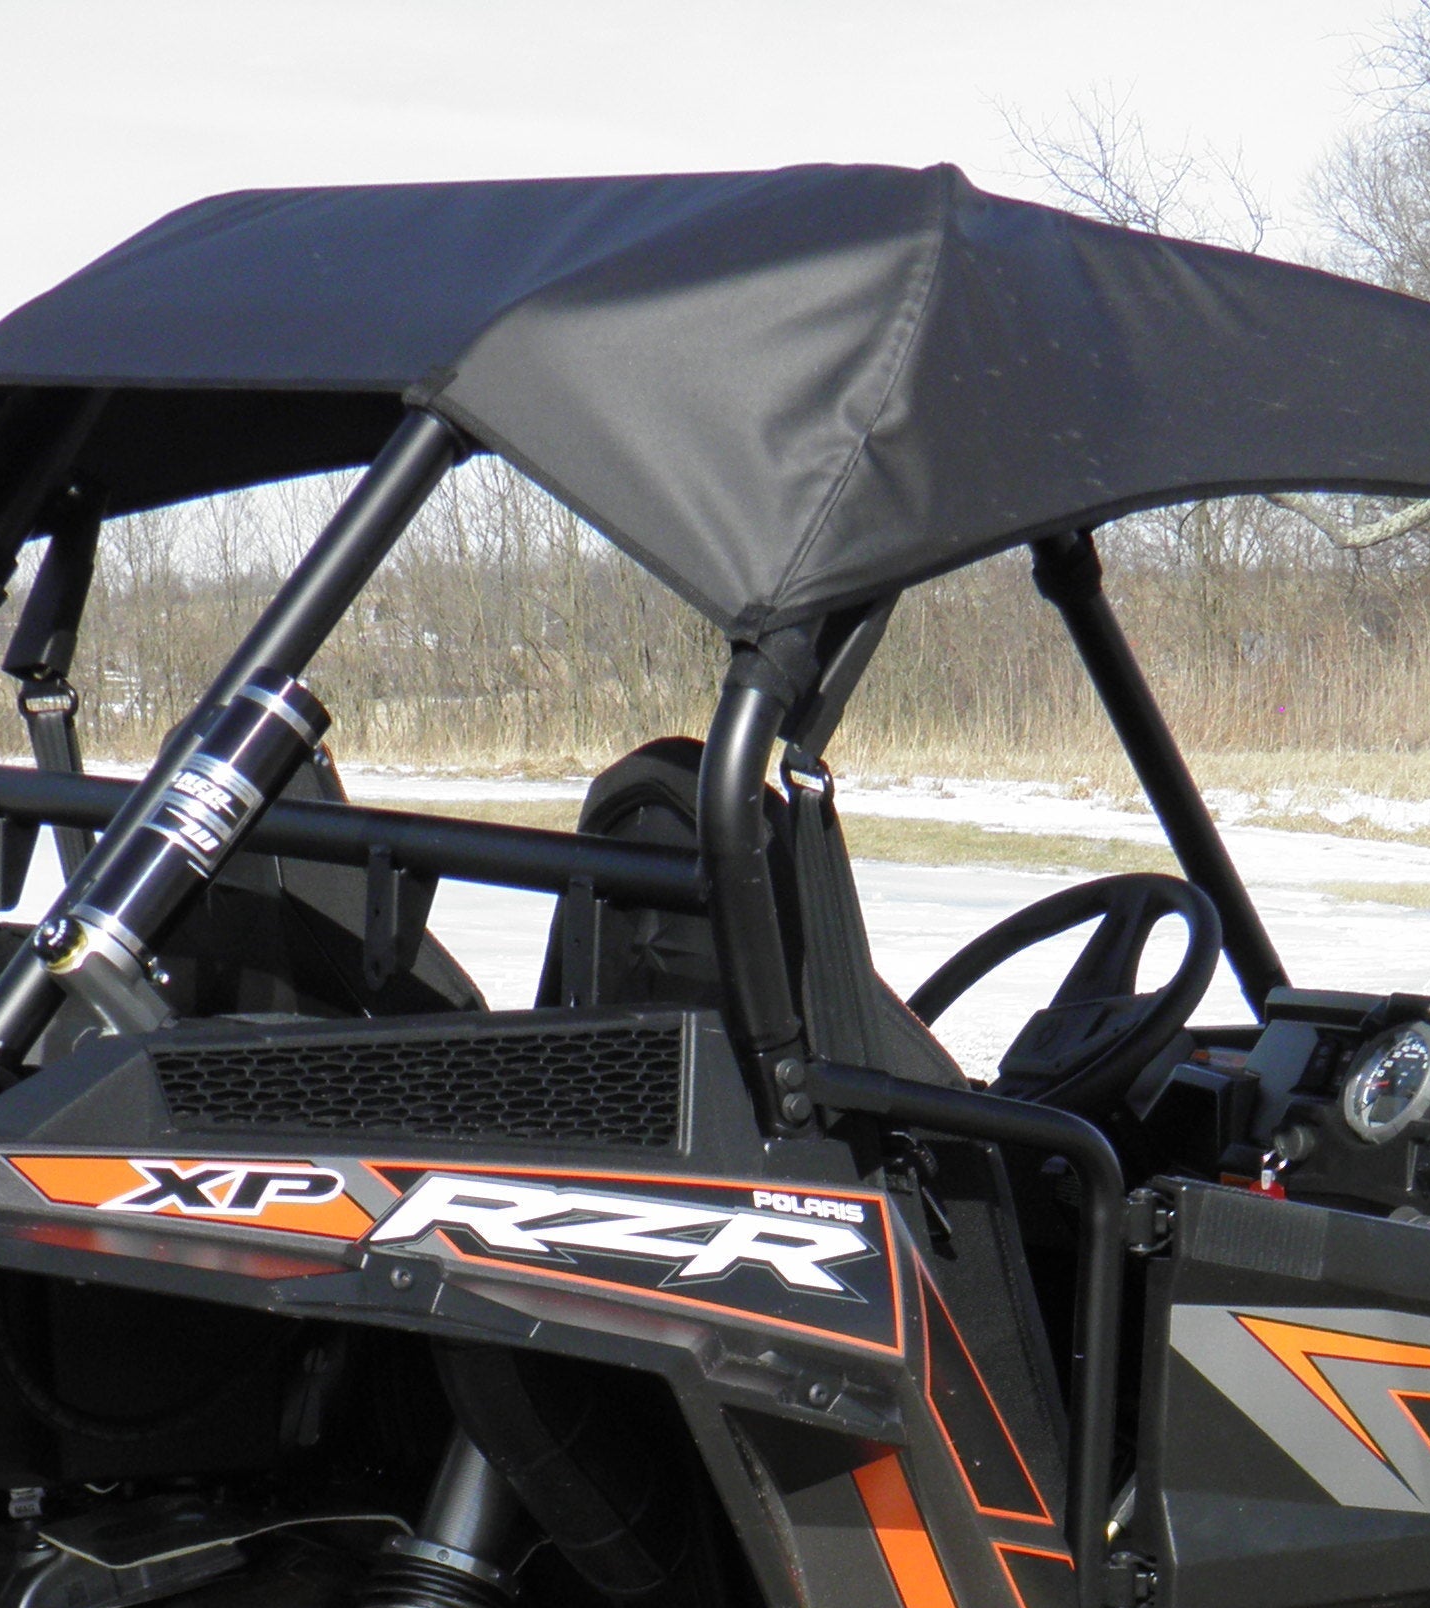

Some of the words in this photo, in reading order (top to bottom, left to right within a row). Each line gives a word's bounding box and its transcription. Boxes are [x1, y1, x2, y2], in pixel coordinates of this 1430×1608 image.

[98, 1159, 346, 1216] XP
[752, 1190, 865, 1223] POLARIS
[371, 1172, 868, 1291] RZR
